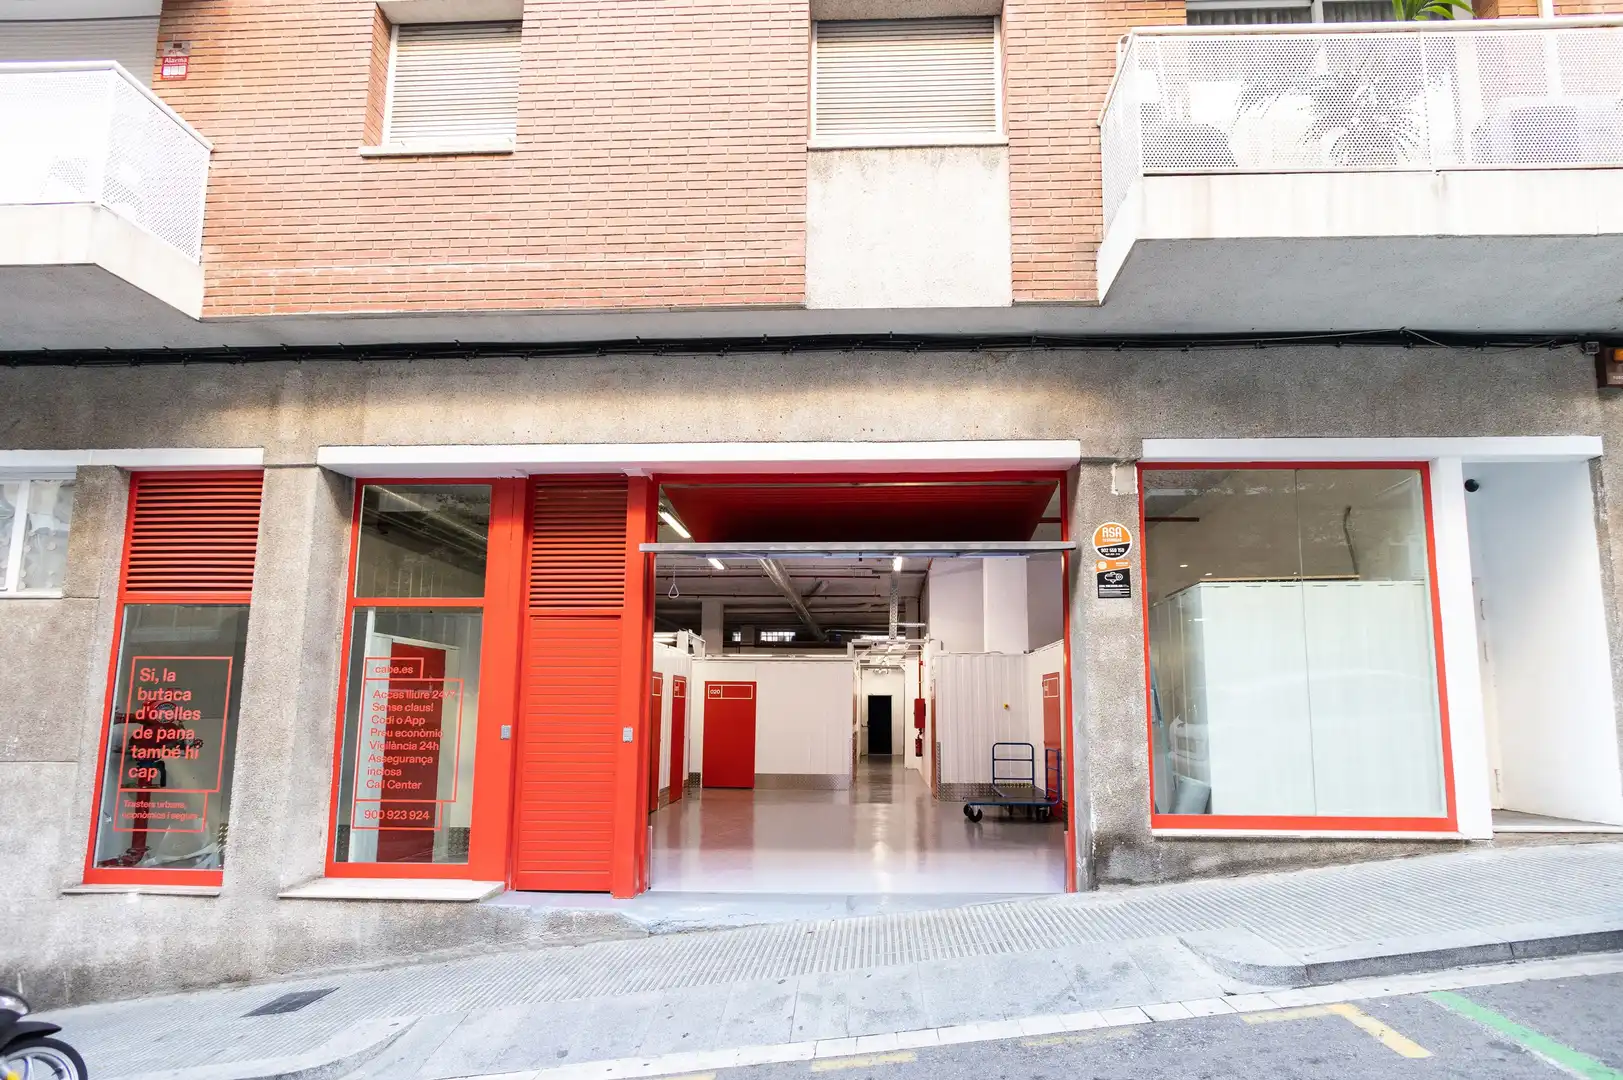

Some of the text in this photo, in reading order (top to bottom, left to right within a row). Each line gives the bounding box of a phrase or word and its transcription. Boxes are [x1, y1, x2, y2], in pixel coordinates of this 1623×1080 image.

[1102, 527, 1122, 538] RSA
[375, 664, 414, 674] cabe.es
[163, 668, 177, 682] la
[137, 687, 192, 702] butaca
[406, 690, 431, 700] lliure
[372, 702, 435, 713] Sense claus!
[135, 706, 201, 721] d'orelles
[371, 715, 426, 727] Codi o App
[133, 725, 196, 746] de pana
[370, 727, 443, 738] Preu econòmic
[369, 740, 440, 751] Vigilància 24h
[130, 744, 182, 760] també
[368, 753, 433, 766] Assegurança
[127, 767, 158, 782] cap
[367, 766, 402, 777] inclosa
[366, 779, 422, 789] Call Center
[364, 809, 430, 820] 900 923 924
